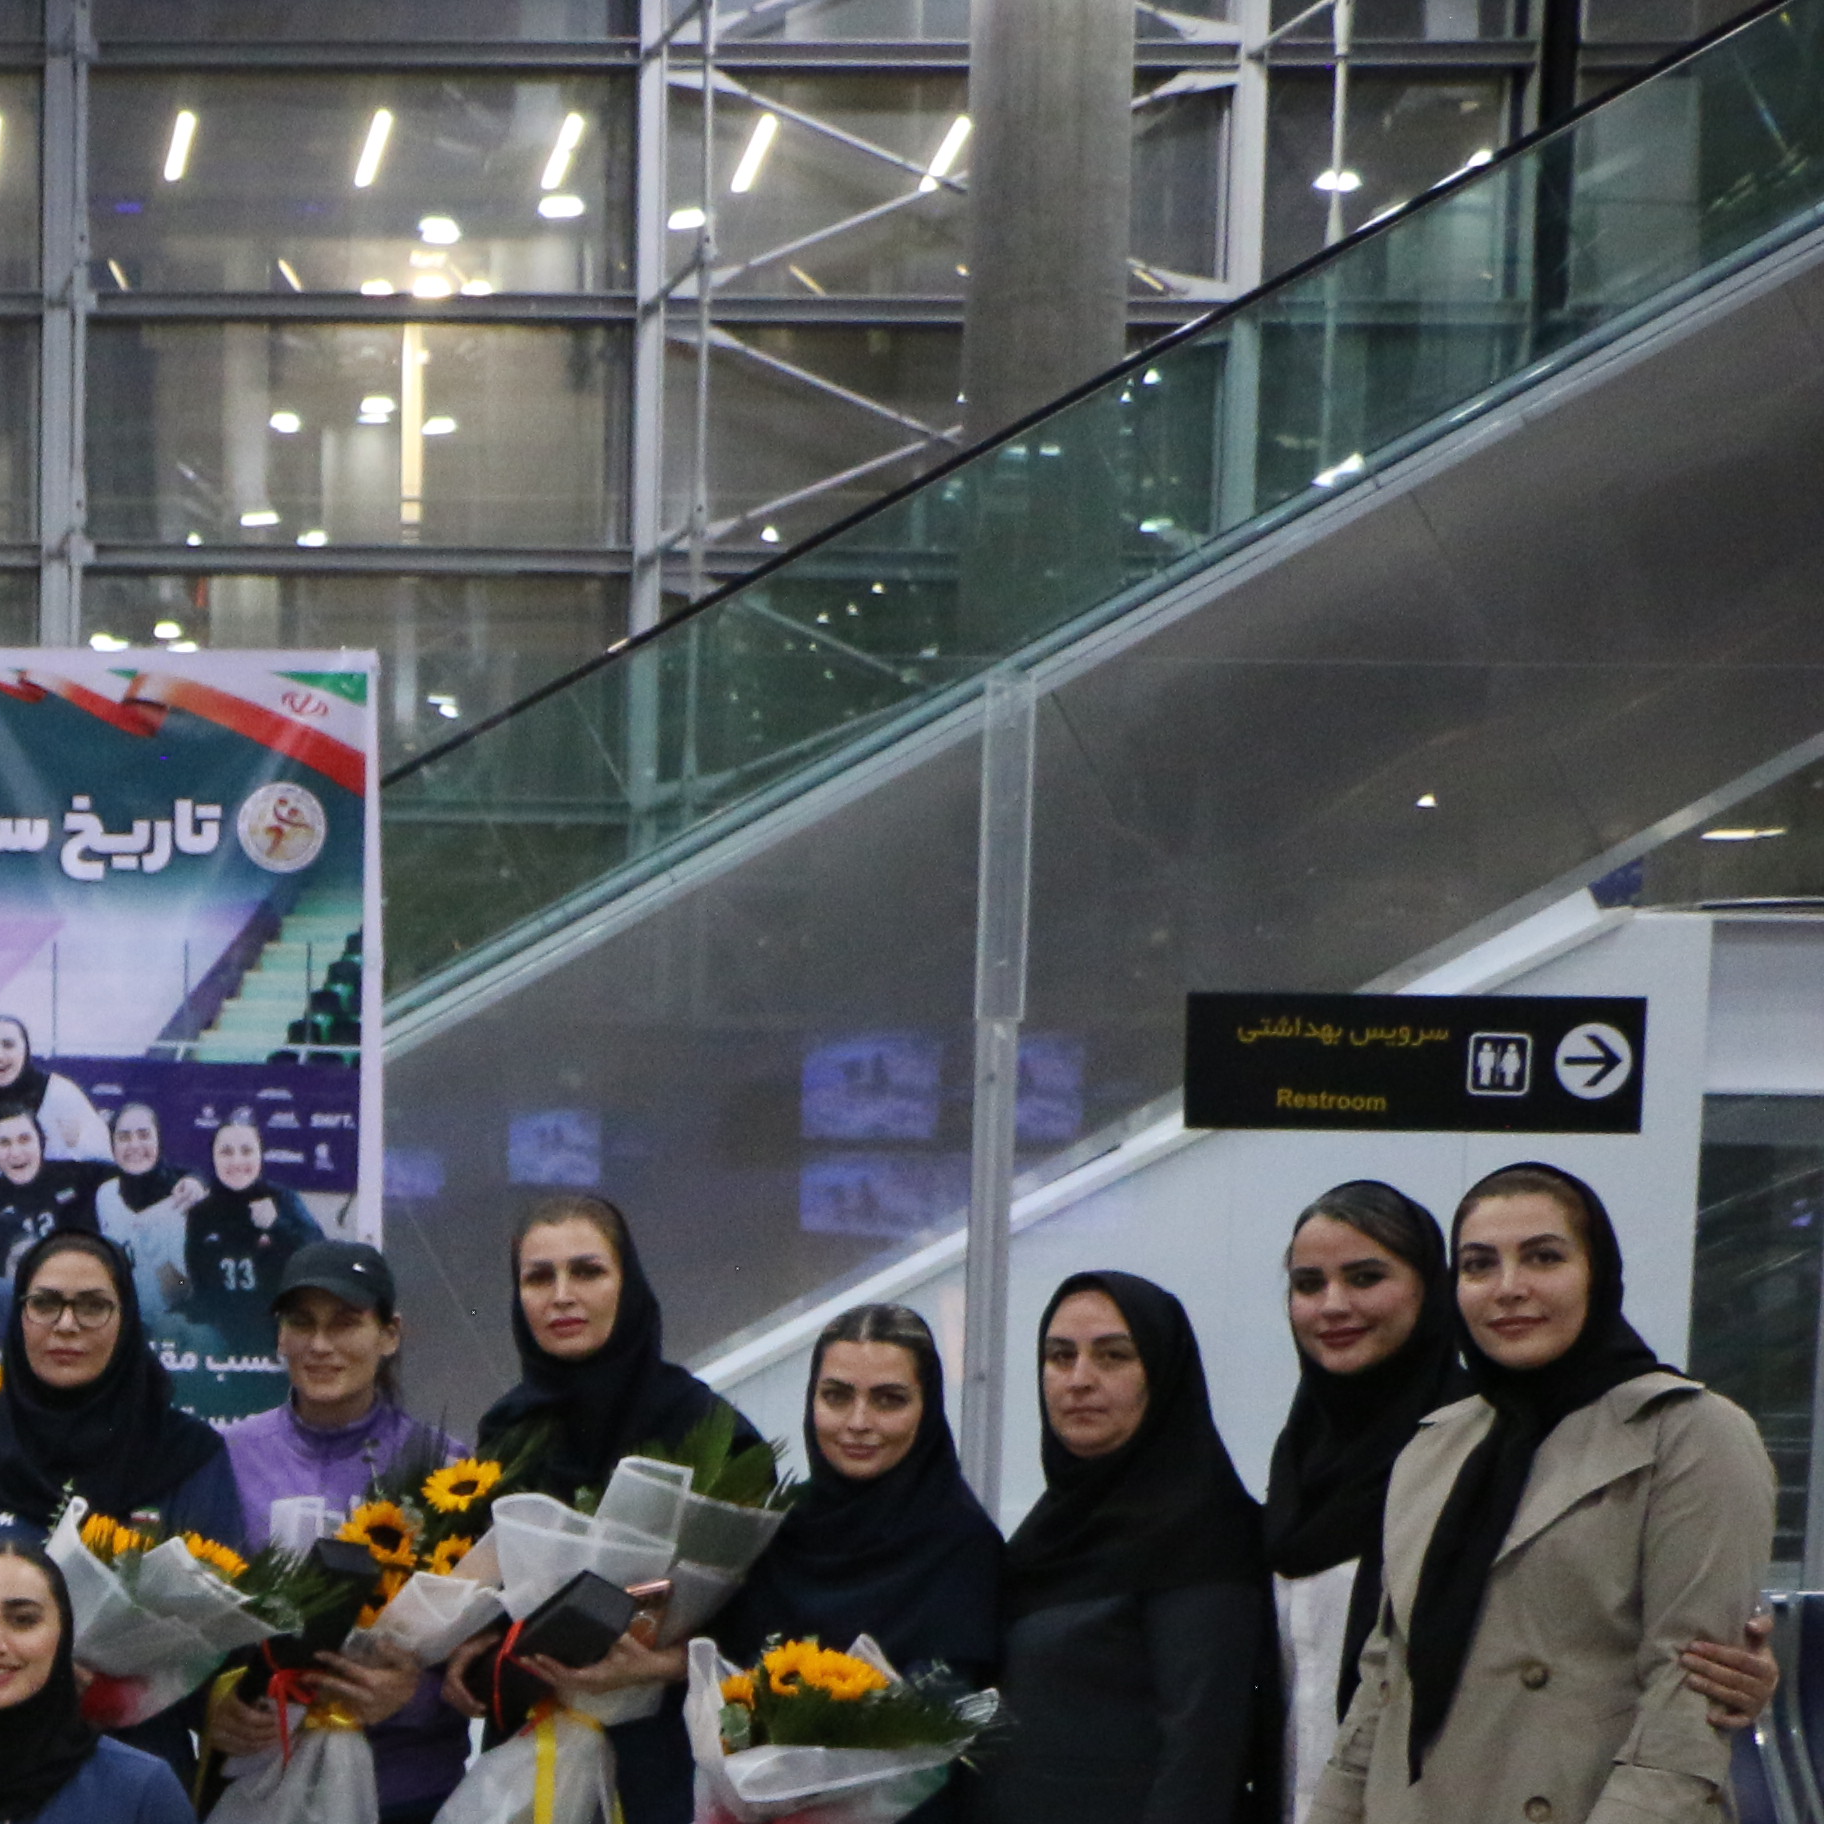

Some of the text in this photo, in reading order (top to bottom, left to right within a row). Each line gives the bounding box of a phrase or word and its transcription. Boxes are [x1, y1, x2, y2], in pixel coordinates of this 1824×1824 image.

[60, 795, 223, 880] تاریخ
[1236, 1015, 1450, 1046] سرویس بهداشتی
[1276, 1087, 1388, 1112] Restroom
[219, 1256, 256, 1292] 33
